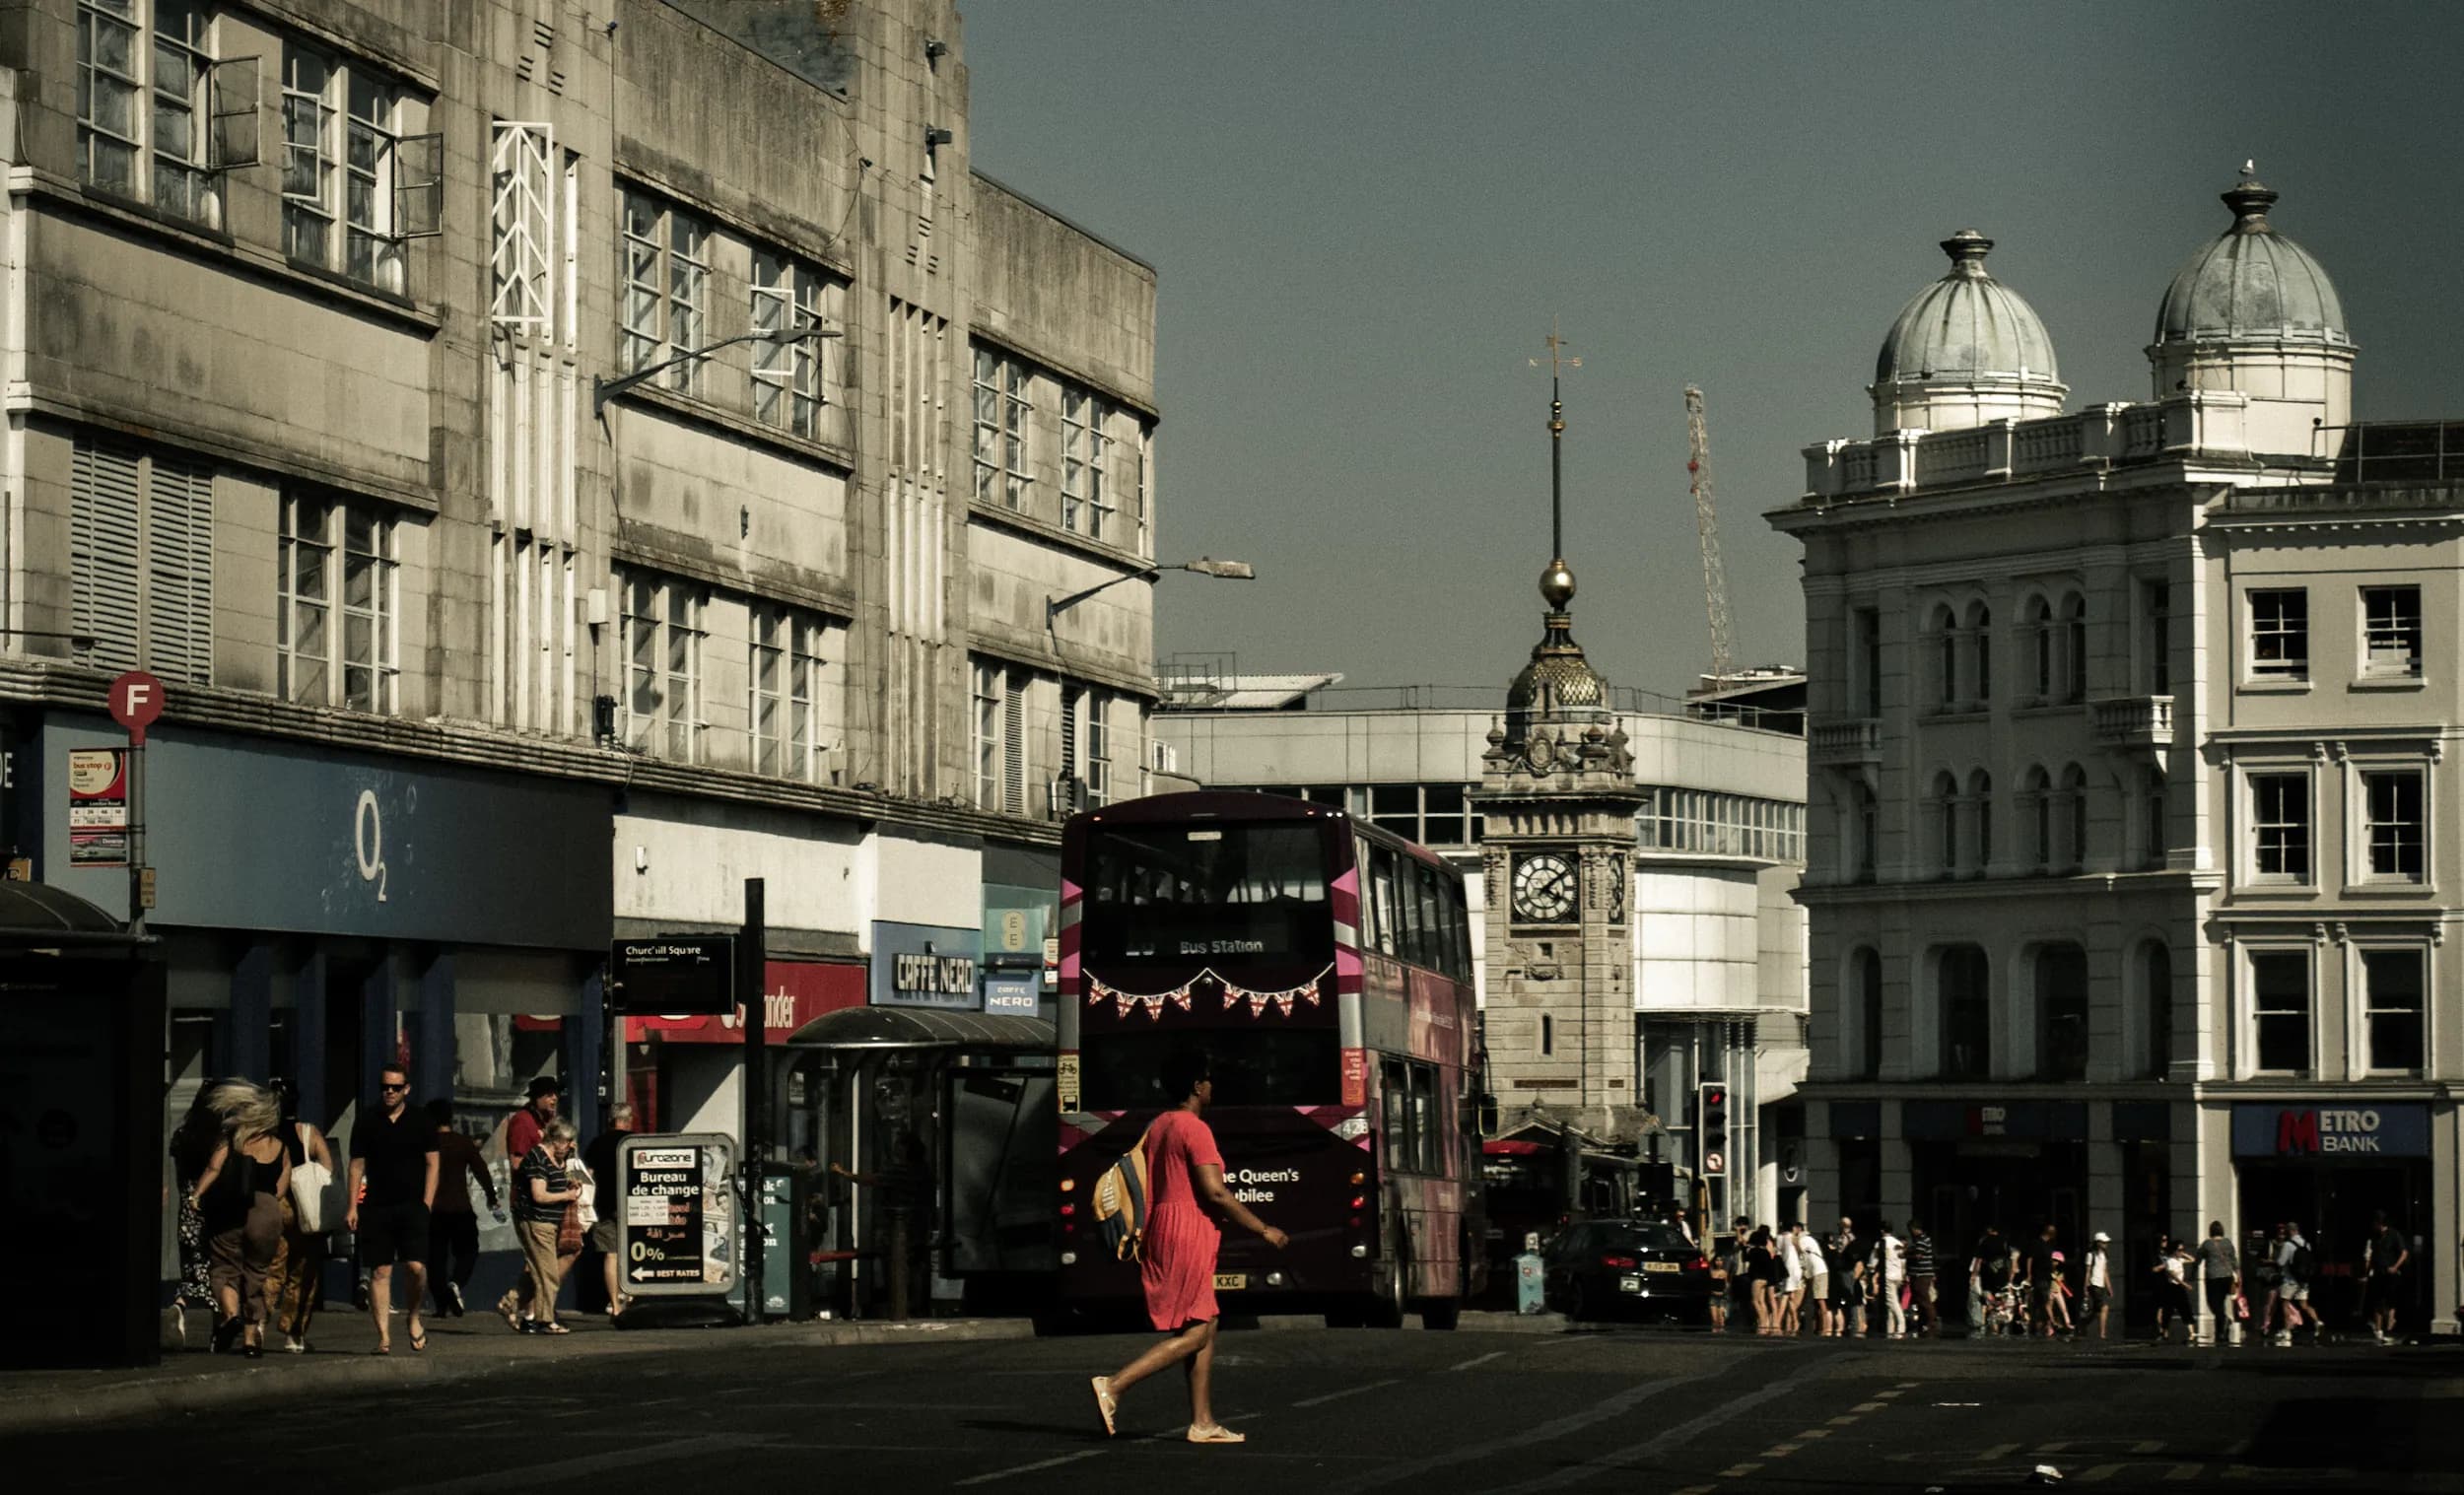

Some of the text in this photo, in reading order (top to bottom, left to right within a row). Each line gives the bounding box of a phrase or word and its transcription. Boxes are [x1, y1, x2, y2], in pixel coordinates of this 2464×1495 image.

[126, 684, 150, 716] F
[625, 946, 701, 956] Churchill Square
[1180, 939, 1265, 954] Bus Station
[939, 957, 974, 993] NERO
[990, 996, 1033, 1007] NERO
[2278, 1110, 2380, 1152] METRO
[2322, 1135, 2381, 1152] BANK
[641, 1172, 687, 1183] Bureau
[1239, 1168, 1300, 1185] Queen's
[632, 1185, 699, 1197] de change
[631, 1241, 665, 1261] 0%
[1216, 1275, 1239, 1286] KXC
